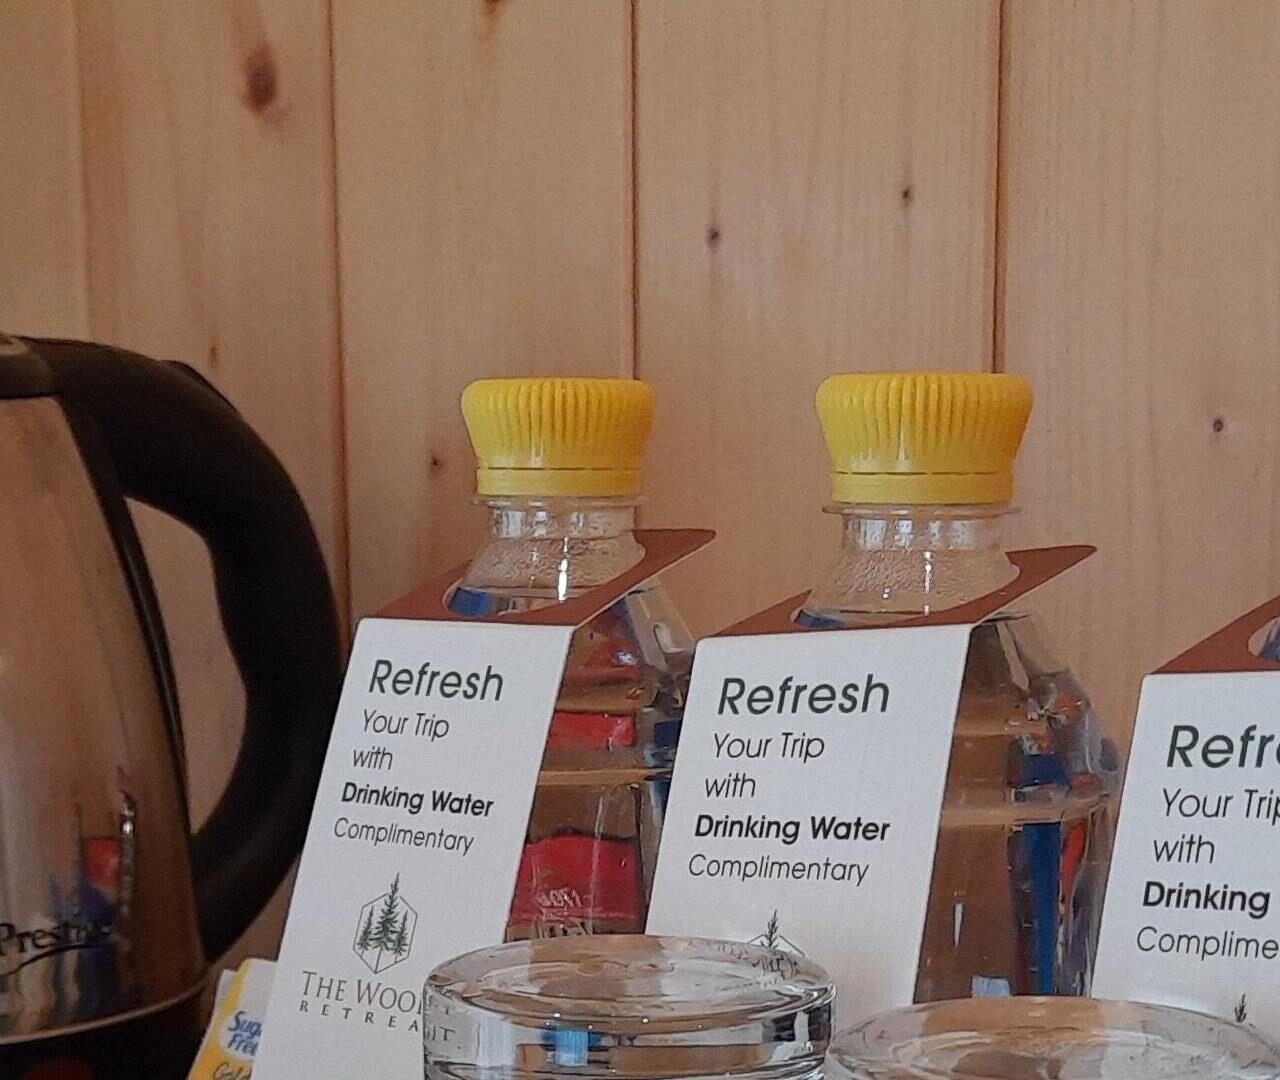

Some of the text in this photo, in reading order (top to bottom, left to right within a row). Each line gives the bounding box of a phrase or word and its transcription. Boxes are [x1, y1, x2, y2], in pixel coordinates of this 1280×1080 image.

[368, 659, 504, 702] Refresh
[717, 673, 890, 716] Refresh
[363, 709, 450, 740] Your Trip
[353, 745, 394, 770] with
[714, 732, 826, 764] Your Trip
[341, 782, 494, 817] Drinking Water
[705, 772, 756, 799] with
[1163, 787, 1234, 819] Your
[333, 816, 475, 856] Complimentary
[694, 813, 891, 846] Drinking Water
[1153, 833, 1216, 865] with
[688, 853, 870, 887] Complimentary
[1142, 880, 1271, 920] Drinking
[302, 970, 348, 1001] THE
[356, 978, 423, 1016] WOO
[298, 999, 419, 1032] RETREA
